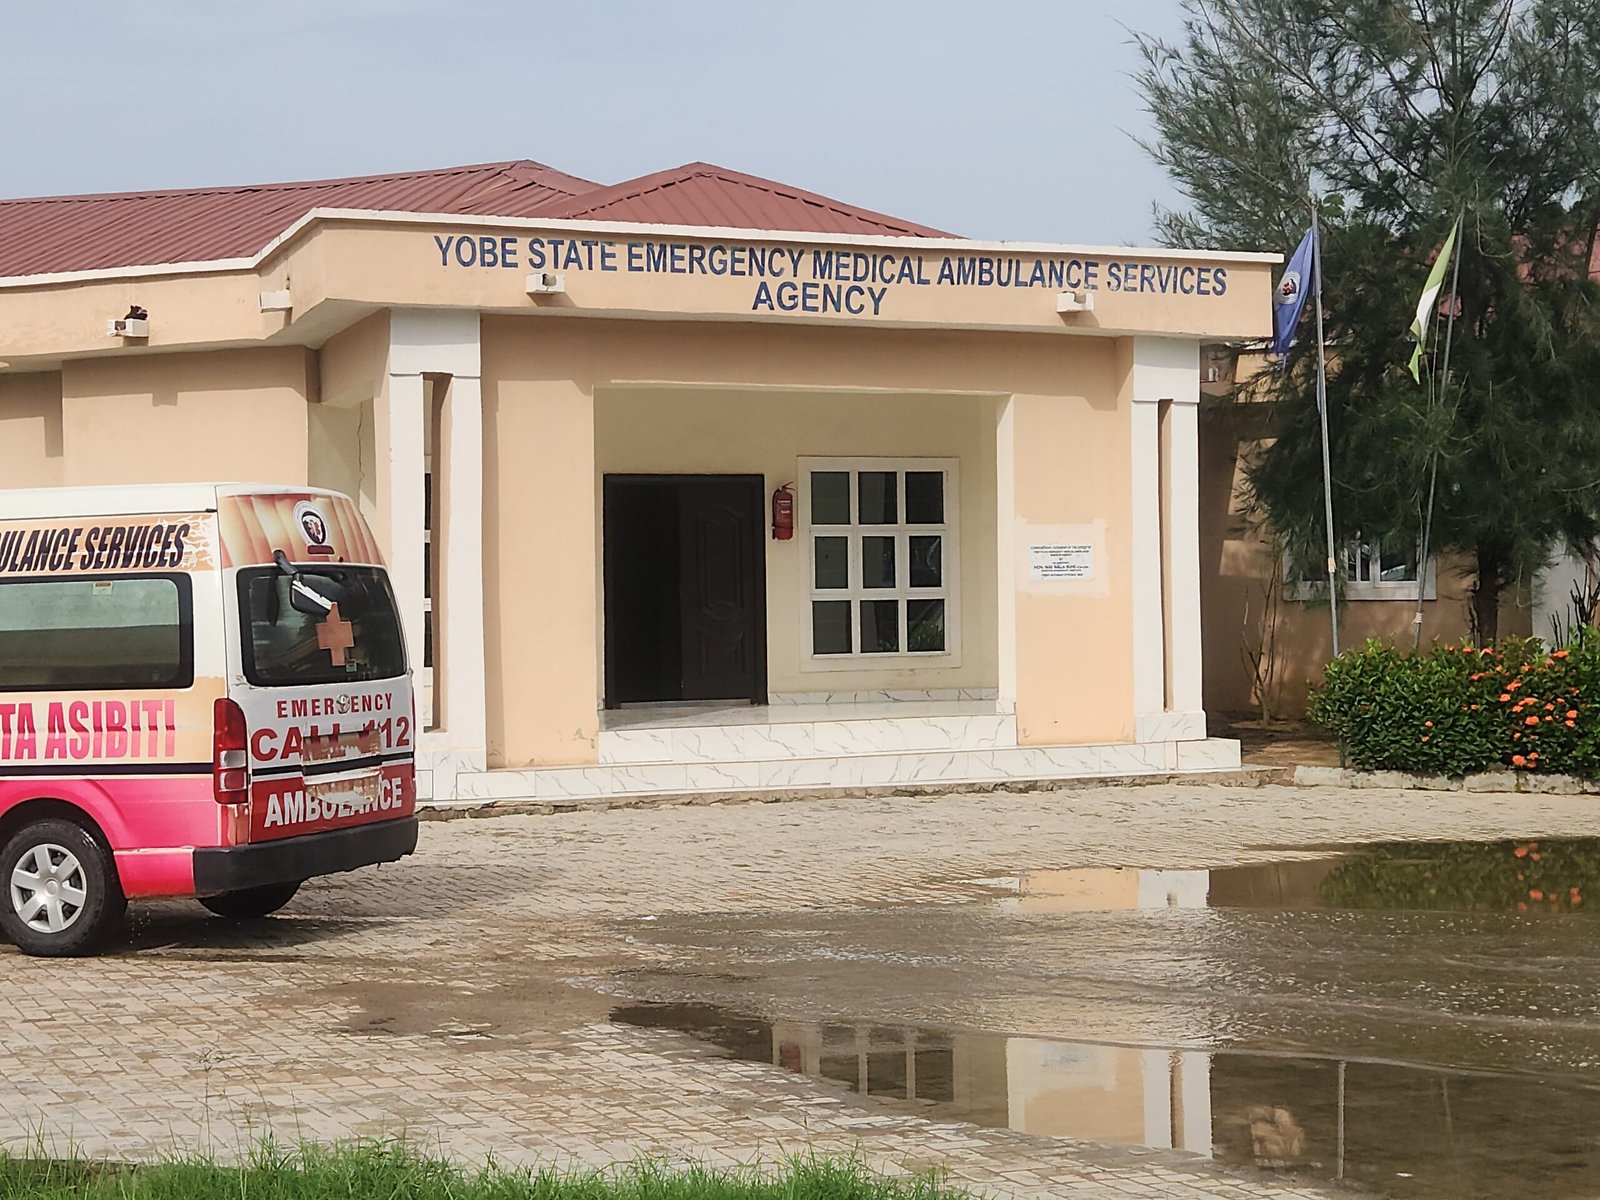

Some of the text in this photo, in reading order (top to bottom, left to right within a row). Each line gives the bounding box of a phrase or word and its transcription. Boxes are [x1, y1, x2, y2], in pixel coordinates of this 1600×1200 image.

[434, 235, 1227, 296] YOBE STATE EMERGENCY MEDICAL AMBULANCE SERVICES
[752, 281, 887, 316] AGENCY
[0, 524, 190, 572] ULANCE SERVICES
[276, 693, 393, 719] EMERENCY
[44, 699, 176, 760] ASIBITI
[359, 716, 410, 753] 112
